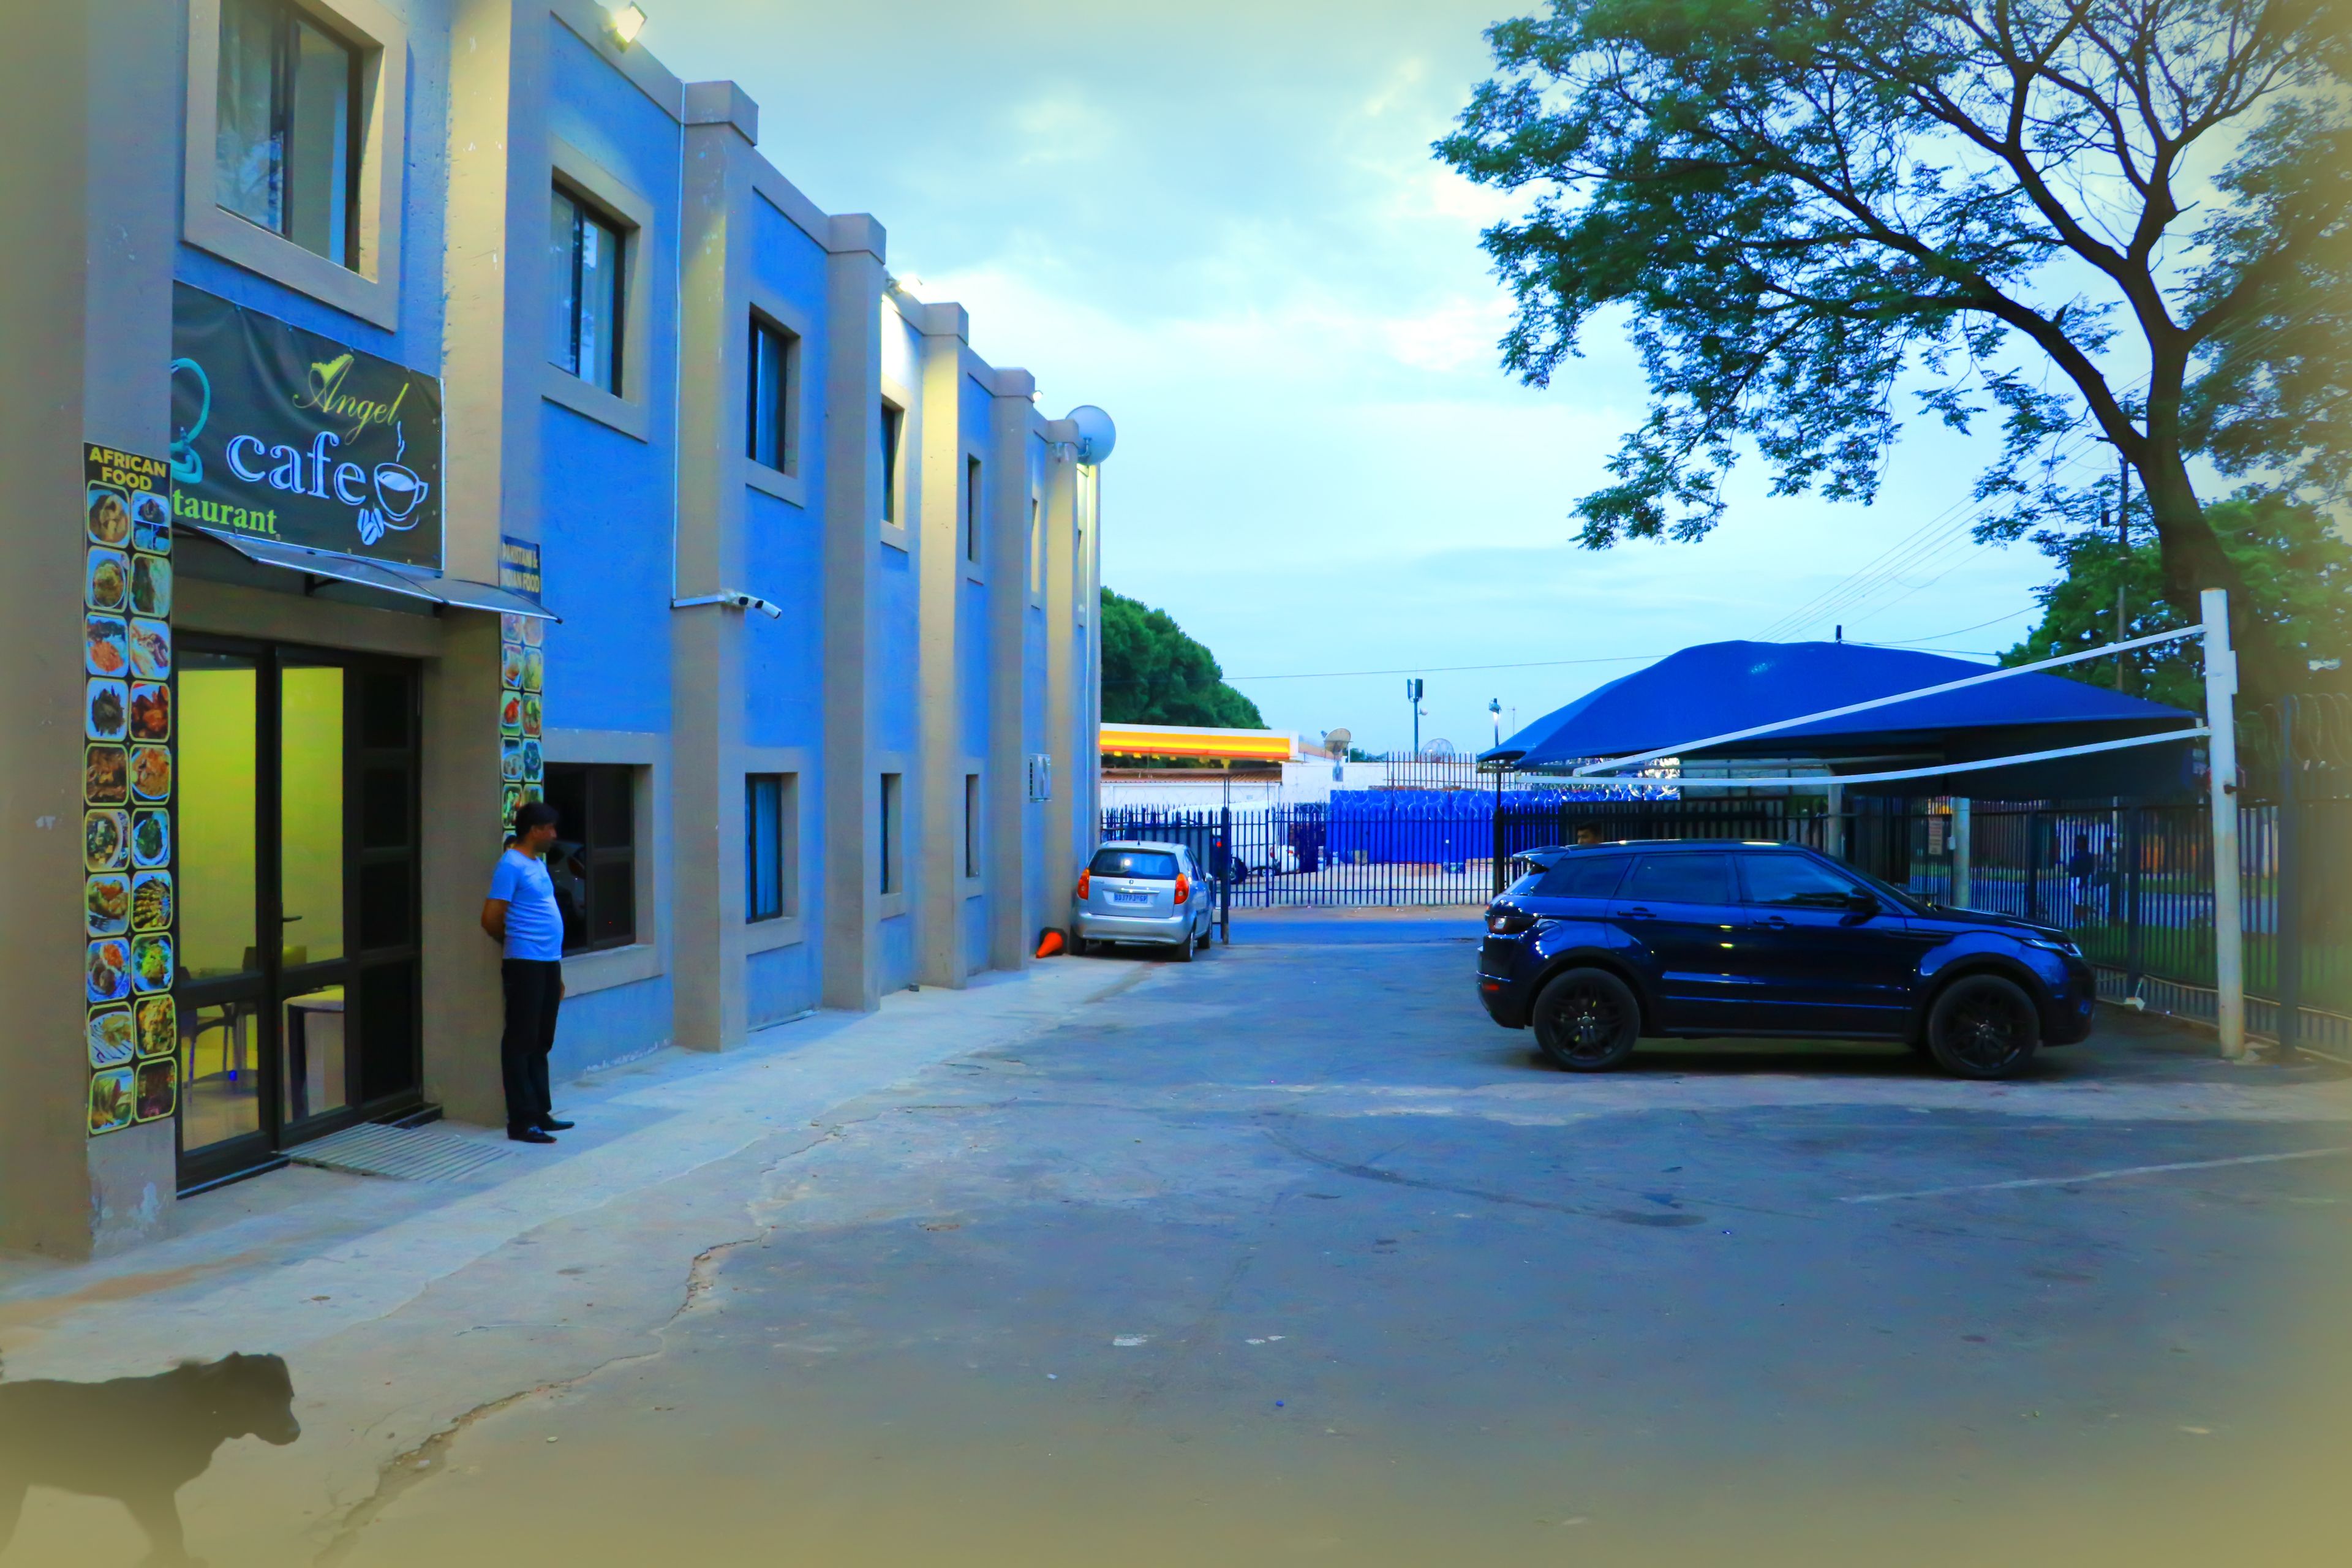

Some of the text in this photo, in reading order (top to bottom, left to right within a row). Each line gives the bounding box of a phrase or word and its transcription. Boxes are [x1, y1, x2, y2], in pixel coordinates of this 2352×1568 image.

[293, 353, 409, 445] Angel
[89, 447, 166, 478] AFRICAN
[226, 431, 366, 506] cafe
[102, 466, 152, 491] FOOD
[522, 573, 540, 593] FOOD
